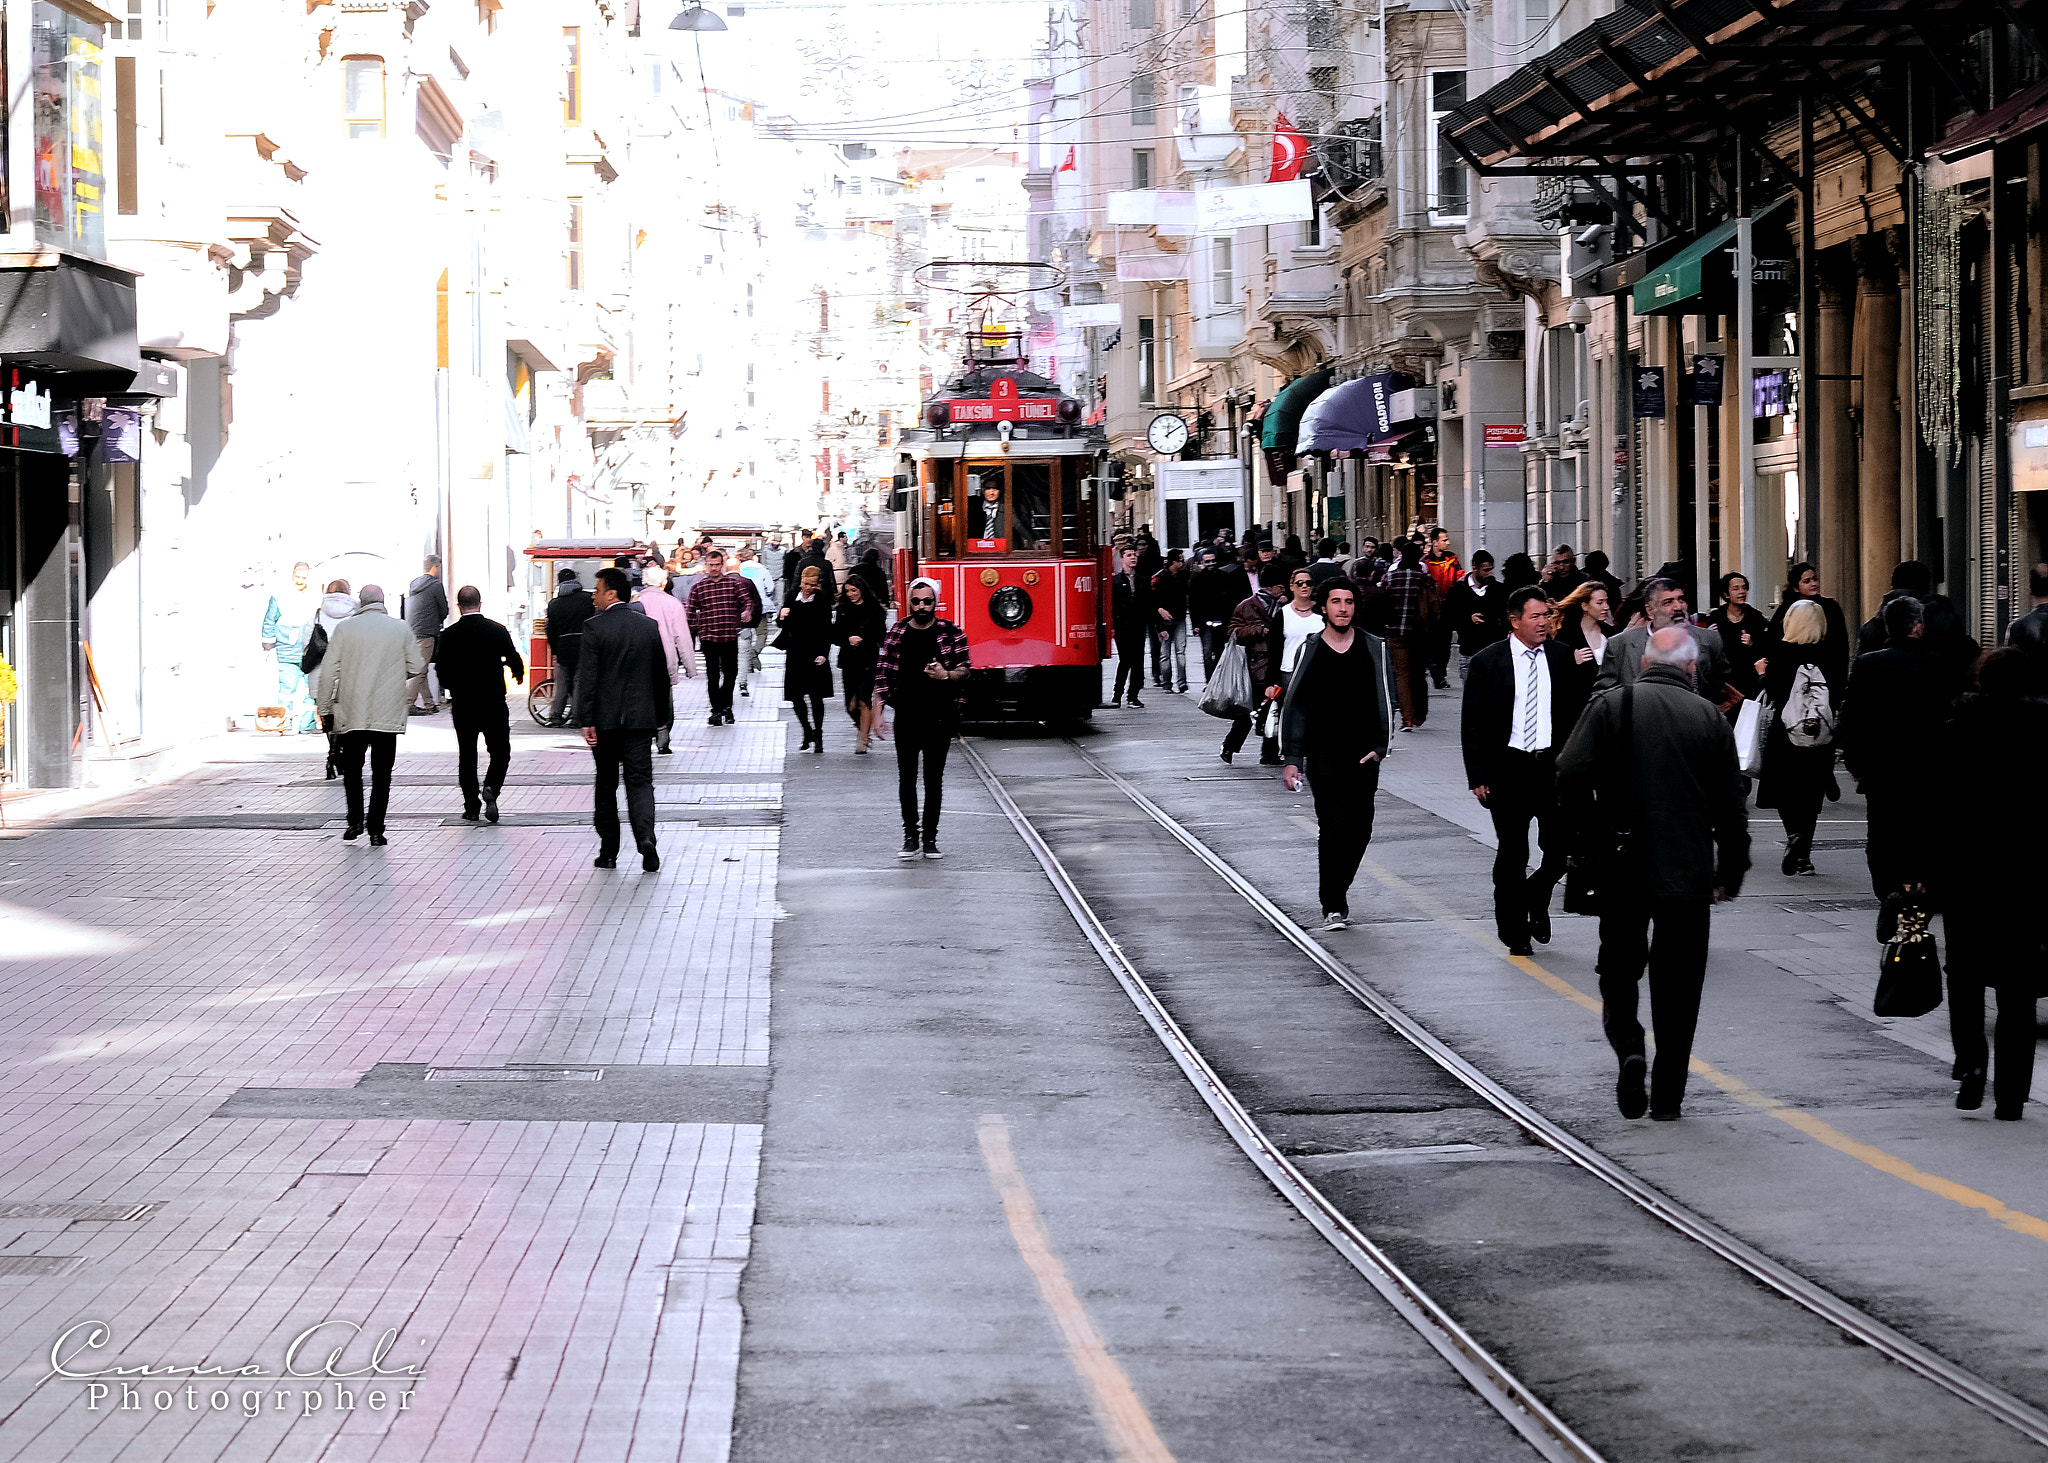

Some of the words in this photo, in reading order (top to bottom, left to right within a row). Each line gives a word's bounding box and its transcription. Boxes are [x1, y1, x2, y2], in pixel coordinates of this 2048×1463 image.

[998, 380, 1009, 397] 3
[1018, 402, 1056, 419] TÜNEL
[1373, 381, 1390, 433] GOLDSTORE
